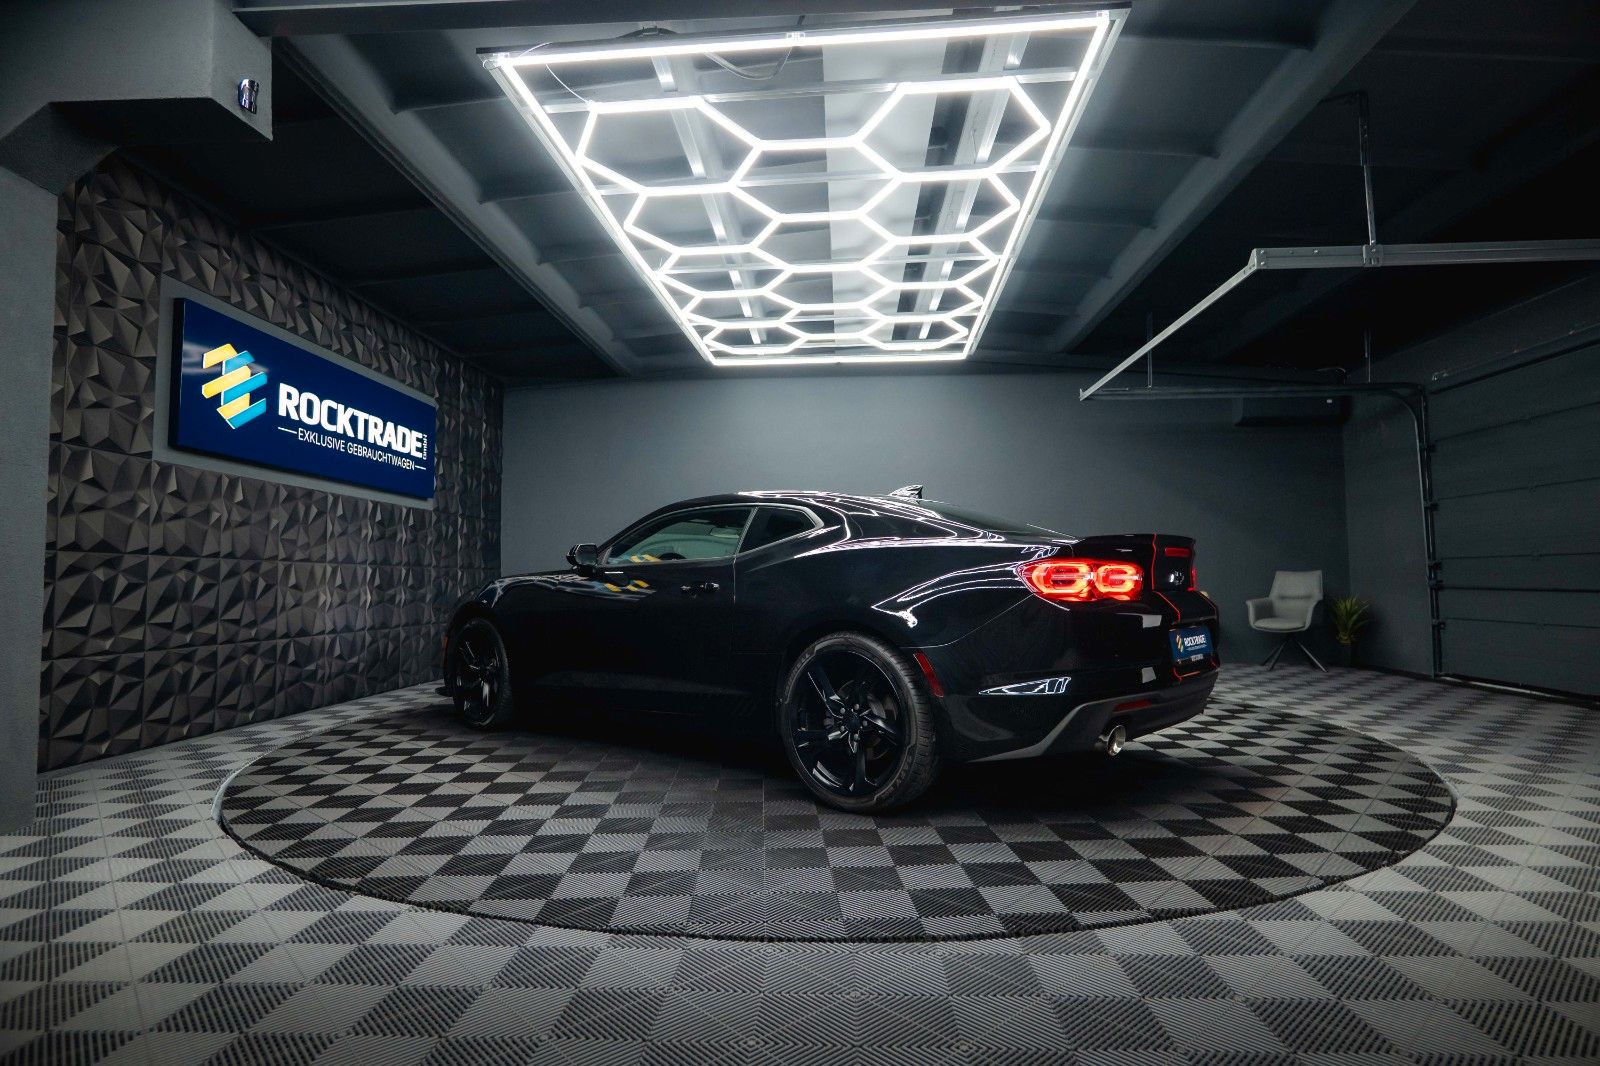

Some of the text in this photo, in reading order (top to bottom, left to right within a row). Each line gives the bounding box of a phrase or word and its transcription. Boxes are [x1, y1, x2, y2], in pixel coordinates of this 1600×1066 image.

[278, 382, 423, 459] ROCKTRADE
[298, 428, 415, 471] EXKLUSIVE GEBRAUCHTWAGEN
